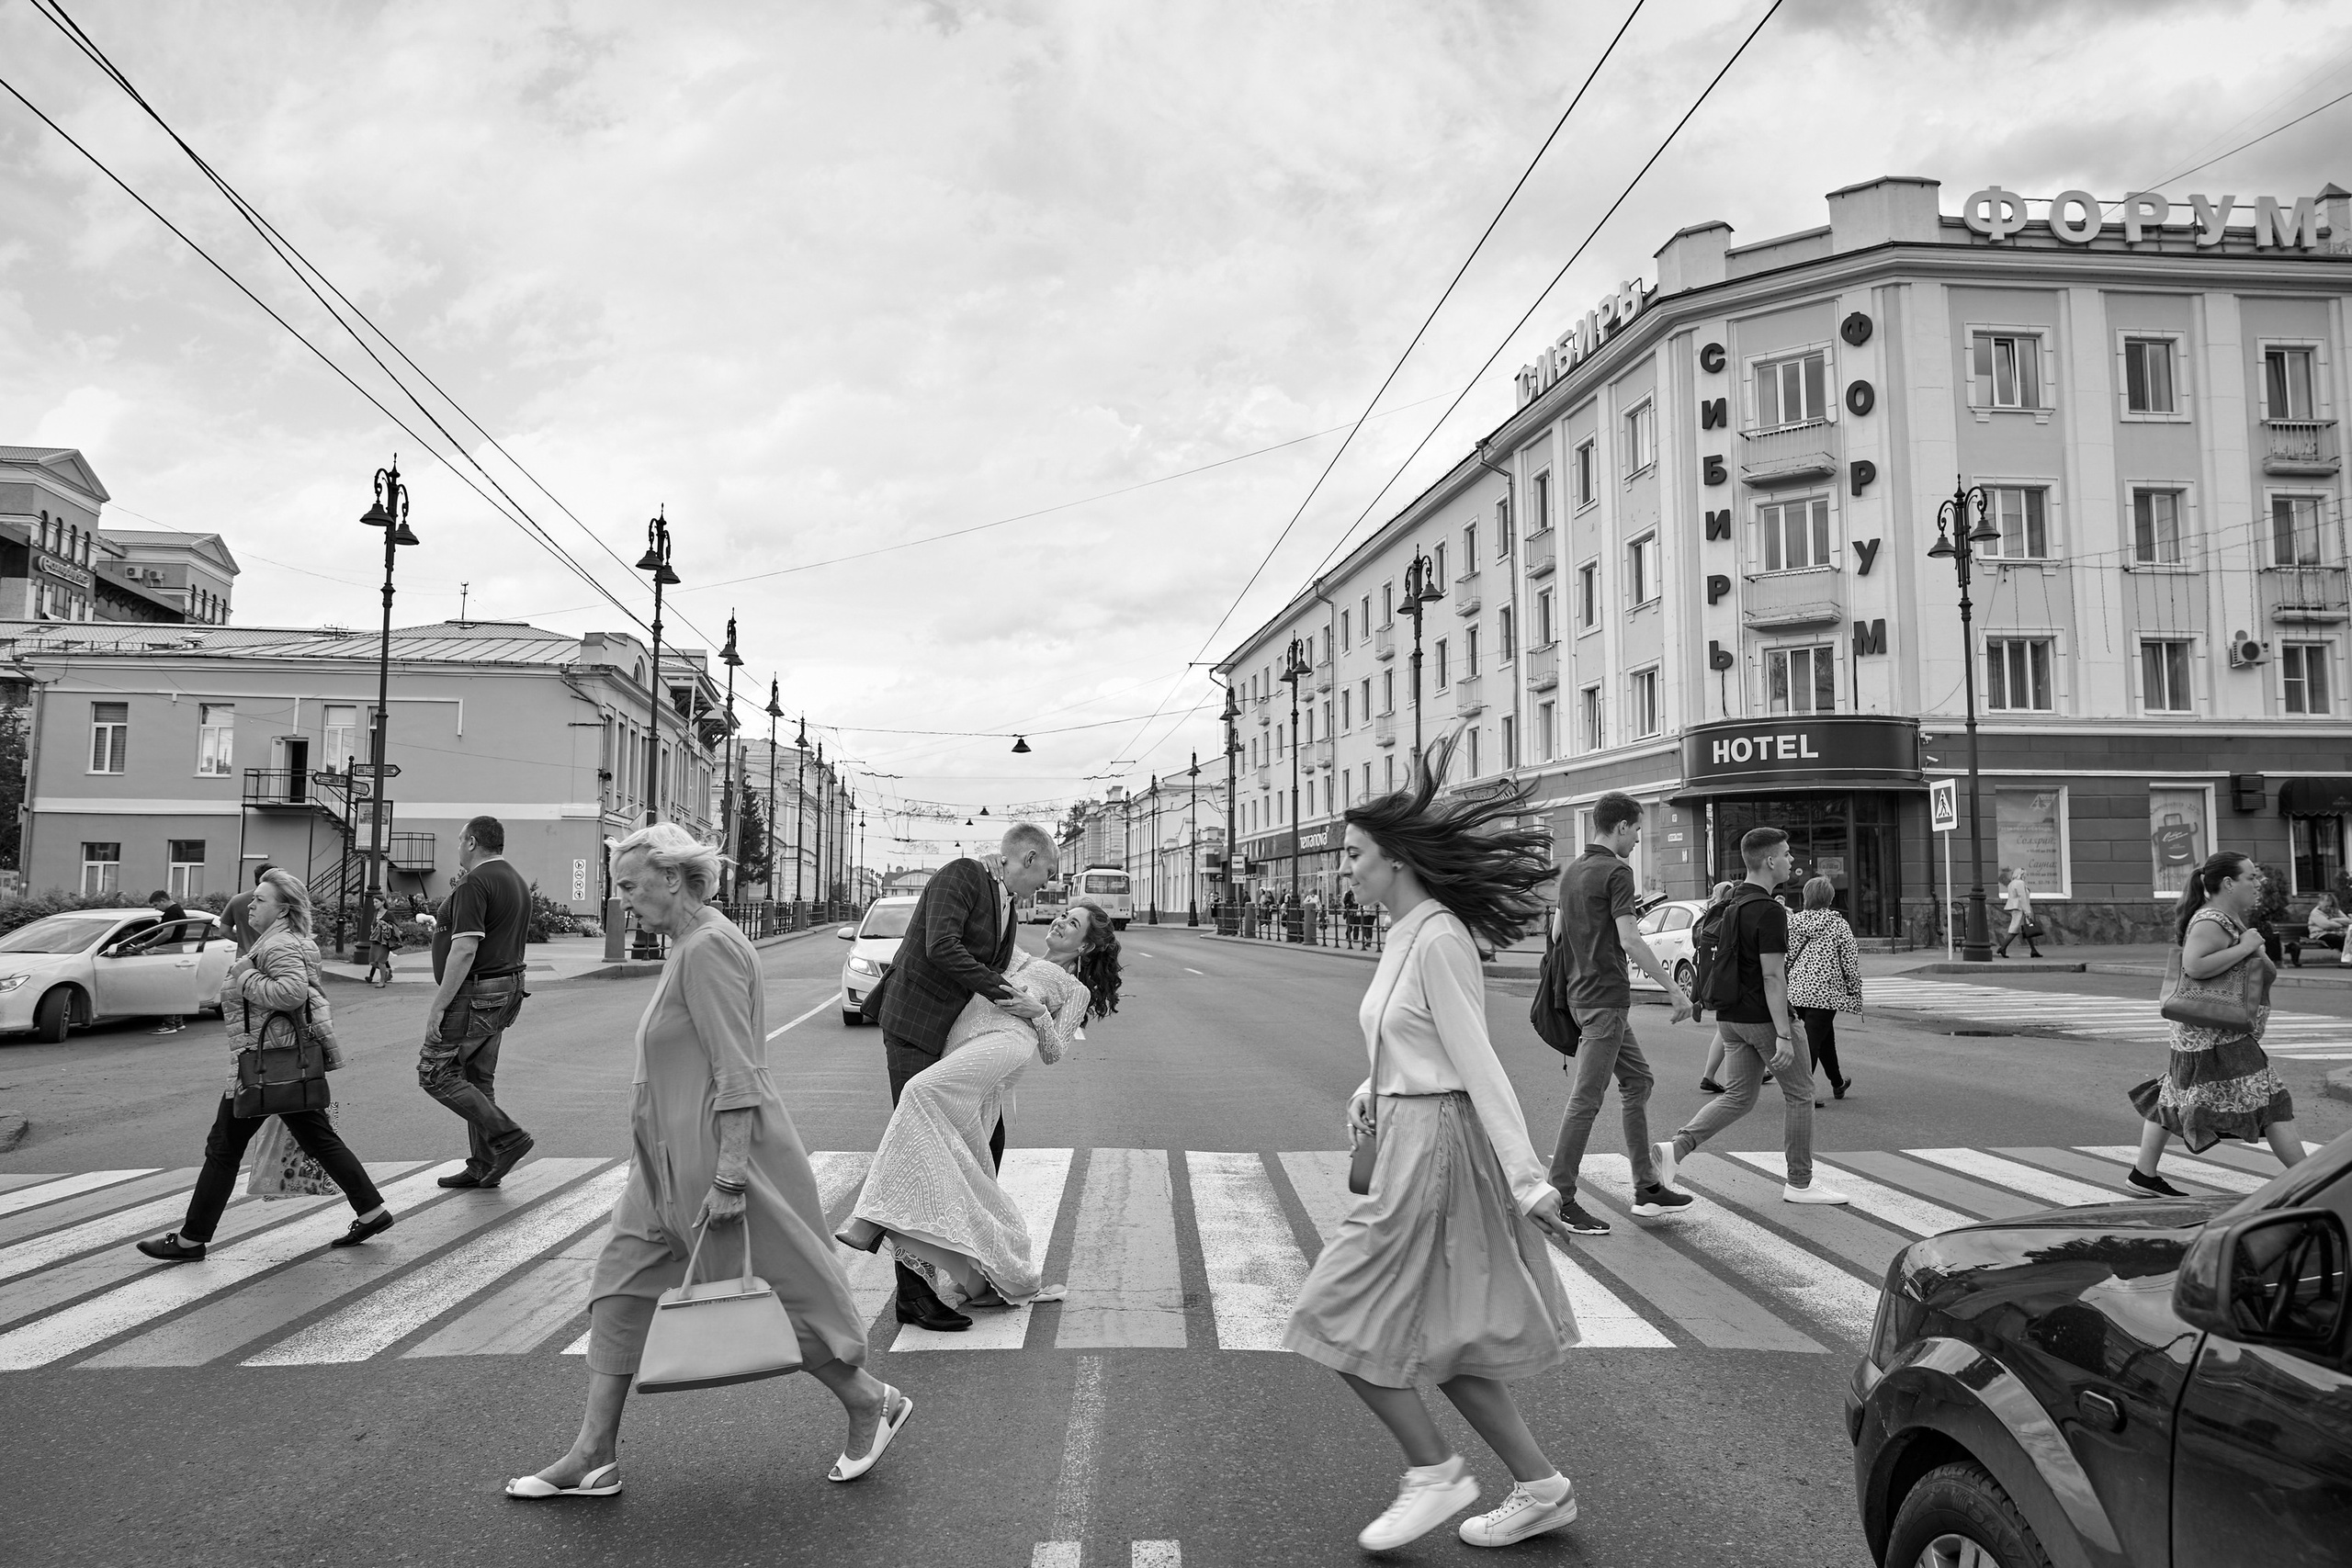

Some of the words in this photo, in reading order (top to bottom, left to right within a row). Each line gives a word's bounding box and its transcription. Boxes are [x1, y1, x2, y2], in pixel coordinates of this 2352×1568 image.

[1962, 186, 2317, 250] ФОРУМ
[1516, 280, 1644, 412] СИБИРЬ
[1700, 343, 1734, 671] СИБИРЬ
[1840, 311, 1886, 656] ФОРУМ
[1713, 734, 1819, 764] HOTEL
